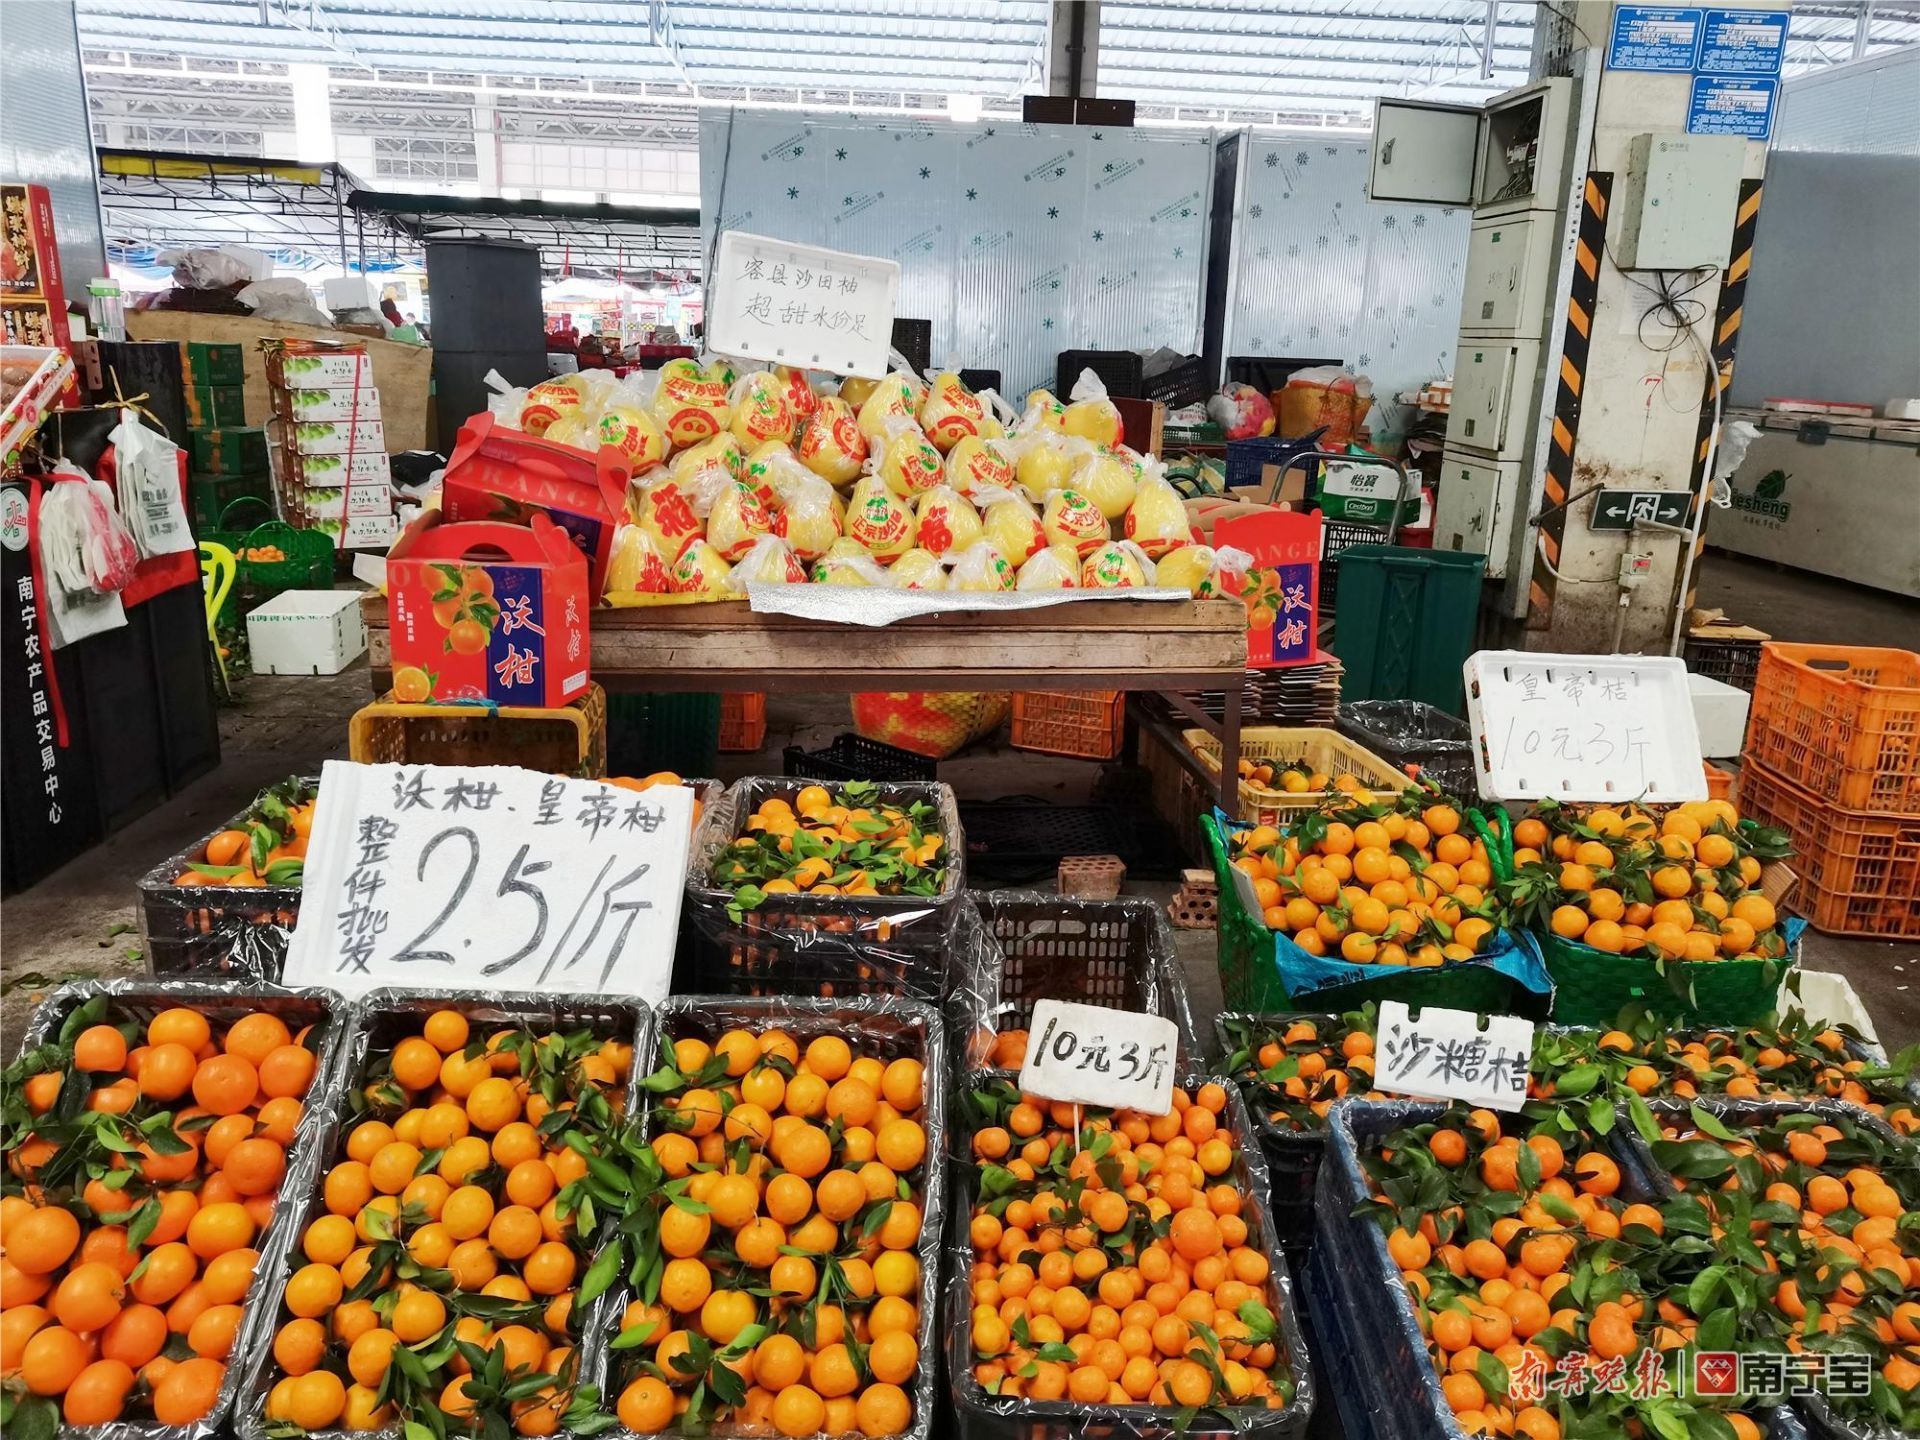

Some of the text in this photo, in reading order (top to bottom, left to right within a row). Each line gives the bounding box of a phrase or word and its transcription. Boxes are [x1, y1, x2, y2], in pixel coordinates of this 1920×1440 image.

[737, 256, 858, 296] 容县沙田柚
[738, 292, 872, 343] 超甜水份足
[494, 594, 546, 689] 沃柑
[1277, 583, 1312, 650] 沃柑
[17, 575, 62, 826] 南宁农产品交易中心
[1515, 672, 1630, 707] 皇帝桔
[335, 813, 400, 975] 整件批发
[389, 825, 653, 993] 2.5/斤
[1032, 1016, 1169, 1090] 10元3斤
[1384, 1023, 1530, 1094] 沙糖桔
